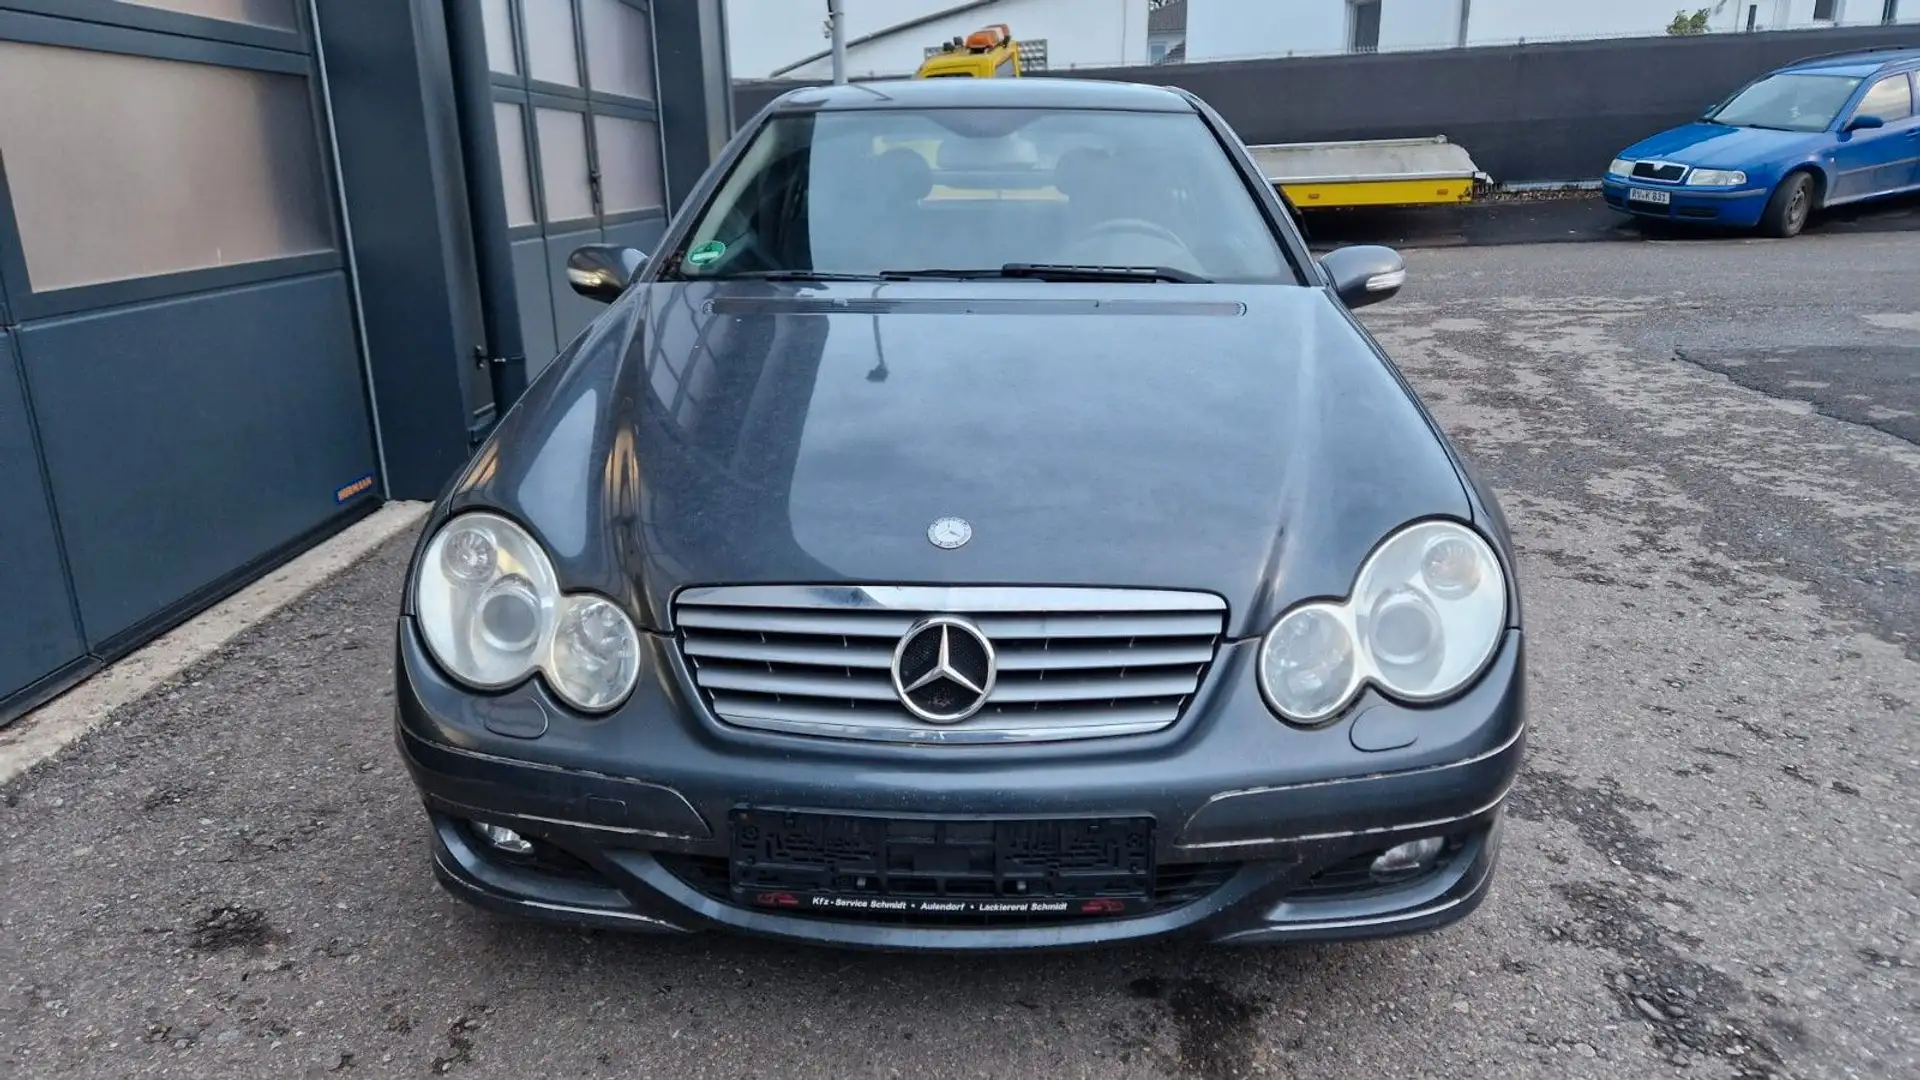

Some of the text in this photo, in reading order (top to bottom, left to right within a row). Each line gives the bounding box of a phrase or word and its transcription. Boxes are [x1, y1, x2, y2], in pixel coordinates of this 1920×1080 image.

[870, 900, 907, 910] Schmidt
[920, 902, 966, 911] Aulendorf
[979, 902, 1028, 912] Lackiererei
[1030, 901, 1068, 911] Schmidt
